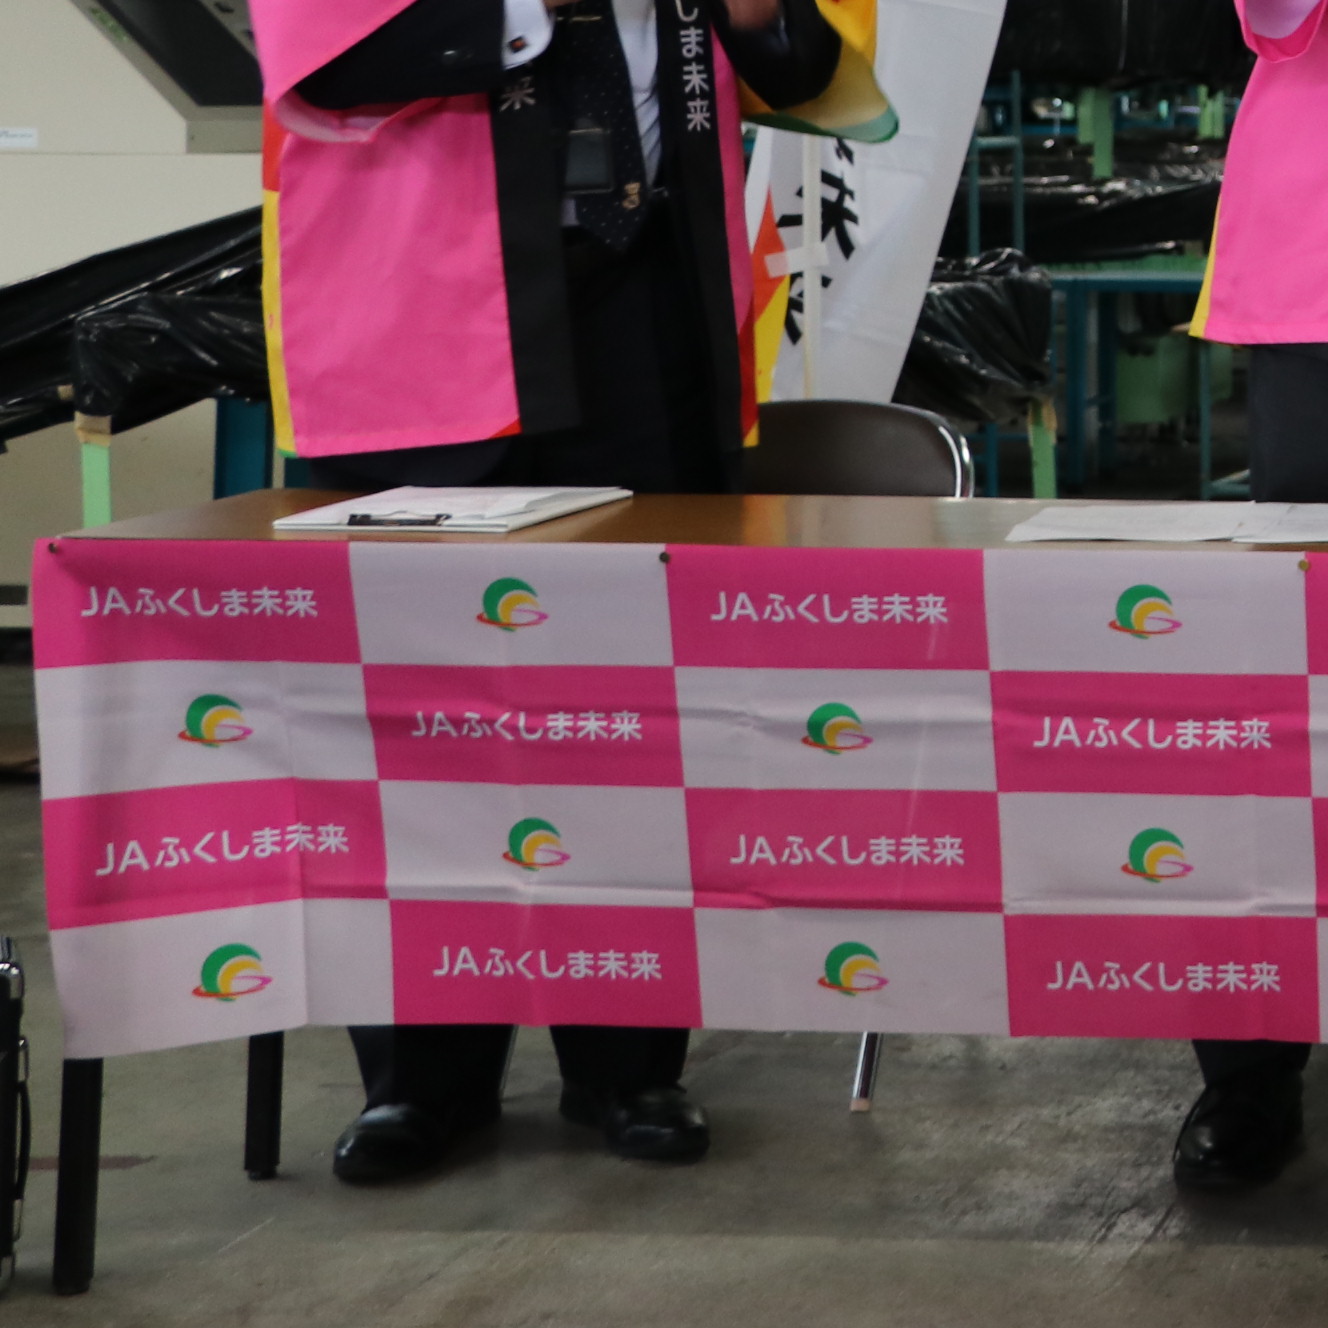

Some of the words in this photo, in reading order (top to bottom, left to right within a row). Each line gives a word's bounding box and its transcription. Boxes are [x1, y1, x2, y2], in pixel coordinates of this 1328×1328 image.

[81, 587, 319, 619] JAふくしま未来
[711, 592, 949, 626] JAふくしま未来
[414, 712, 643, 742] JAふくしま未来
[1034, 717, 1272, 751] JAふくしま未来
[97, 824, 350, 877] JAふくしま未来
[731, 835, 965, 867] JAふくしま未来
[434, 947, 663, 981] JAふくしま未来
[1048, 961, 1282, 994] JAふくしま未来
